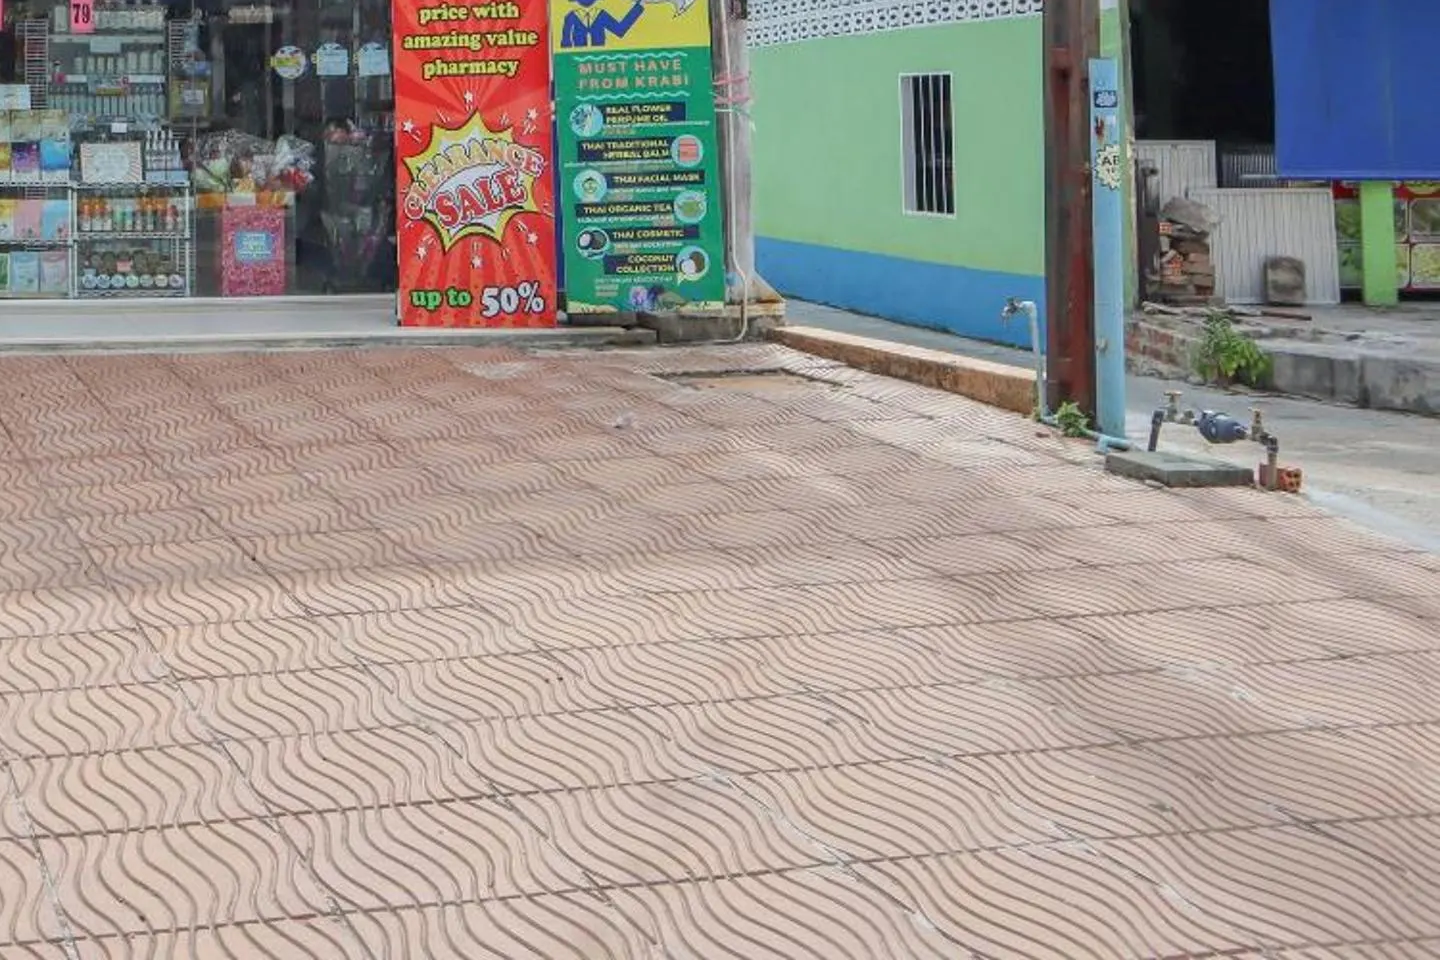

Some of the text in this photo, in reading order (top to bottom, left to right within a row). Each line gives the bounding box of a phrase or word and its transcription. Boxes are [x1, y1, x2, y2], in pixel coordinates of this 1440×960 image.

[72, 4, 90, 24] 79
[419, 1, 520, 24] price with
[403, 29, 539, 50] amazing value
[422, 58, 520, 79] pharmacy
[578, 59, 682, 73] MUST HAVE
[635, 74, 690, 88] KRABI
[435, 168, 525, 227] SALE
[412, 292, 441, 307] up
[482, 283, 544, 316] 50%
